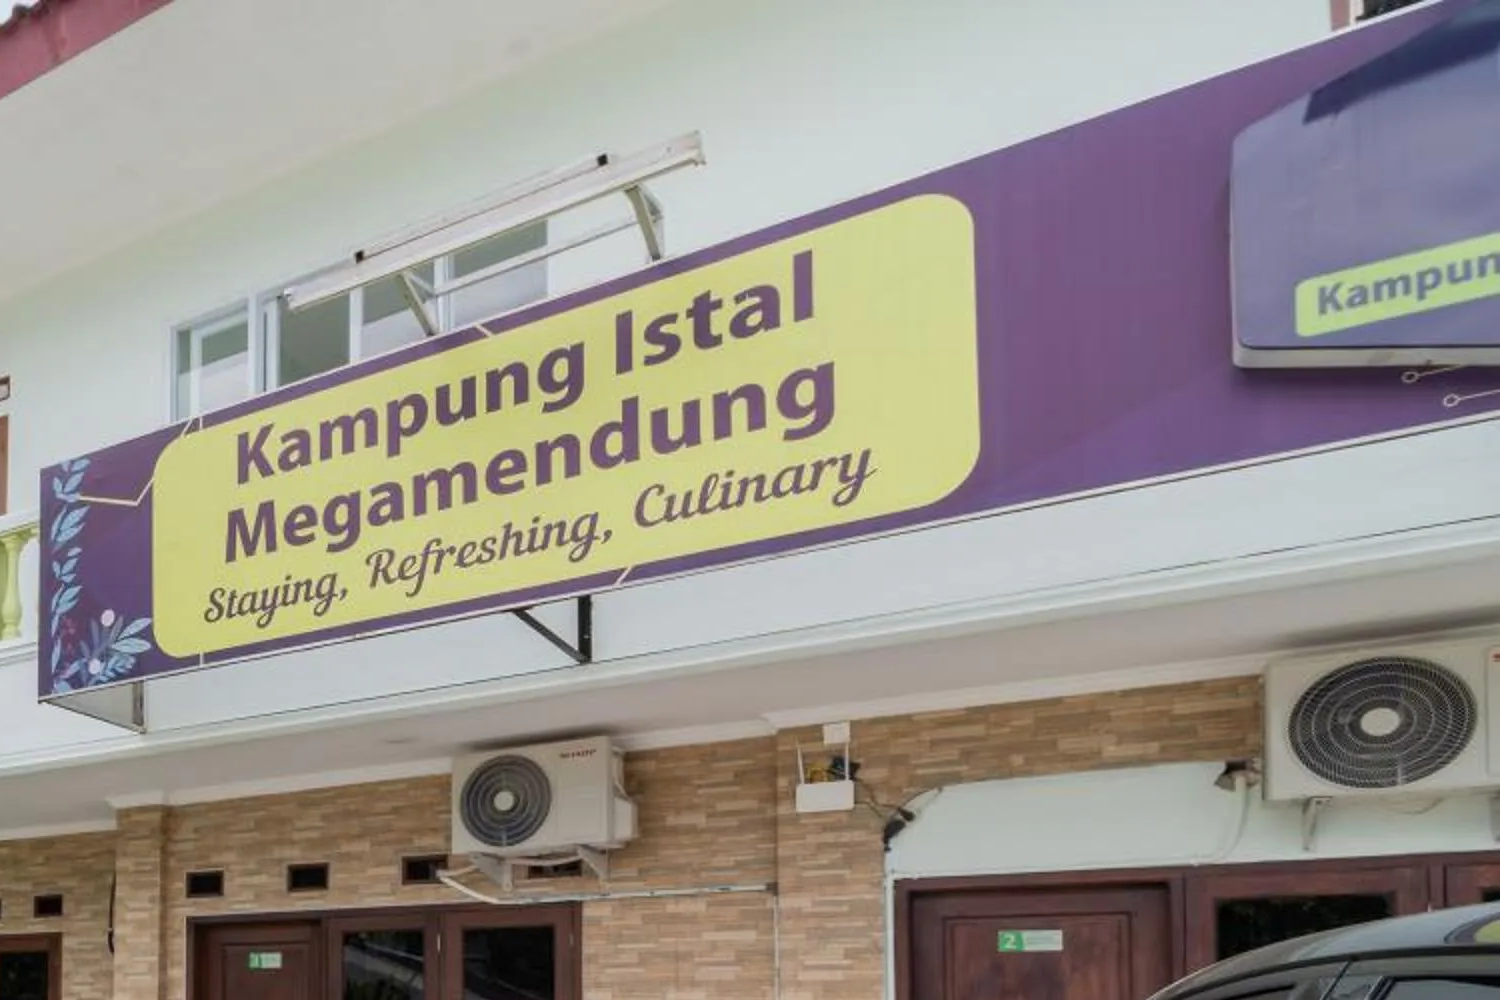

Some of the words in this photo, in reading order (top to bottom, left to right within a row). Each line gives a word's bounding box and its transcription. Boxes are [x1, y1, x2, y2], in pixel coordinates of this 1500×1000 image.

[236, 344, 586, 486] Kampung
[615, 250, 815, 374] Istal
[1316, 252, 1500, 317] Kampun
[203, 571, 348, 629] Staying,
[365, 511, 613, 598] Refreshing,
[634, 448, 877, 528] Culinary
[224, 361, 836, 564] Megamendung
[1002, 932, 1018, 950] 2
